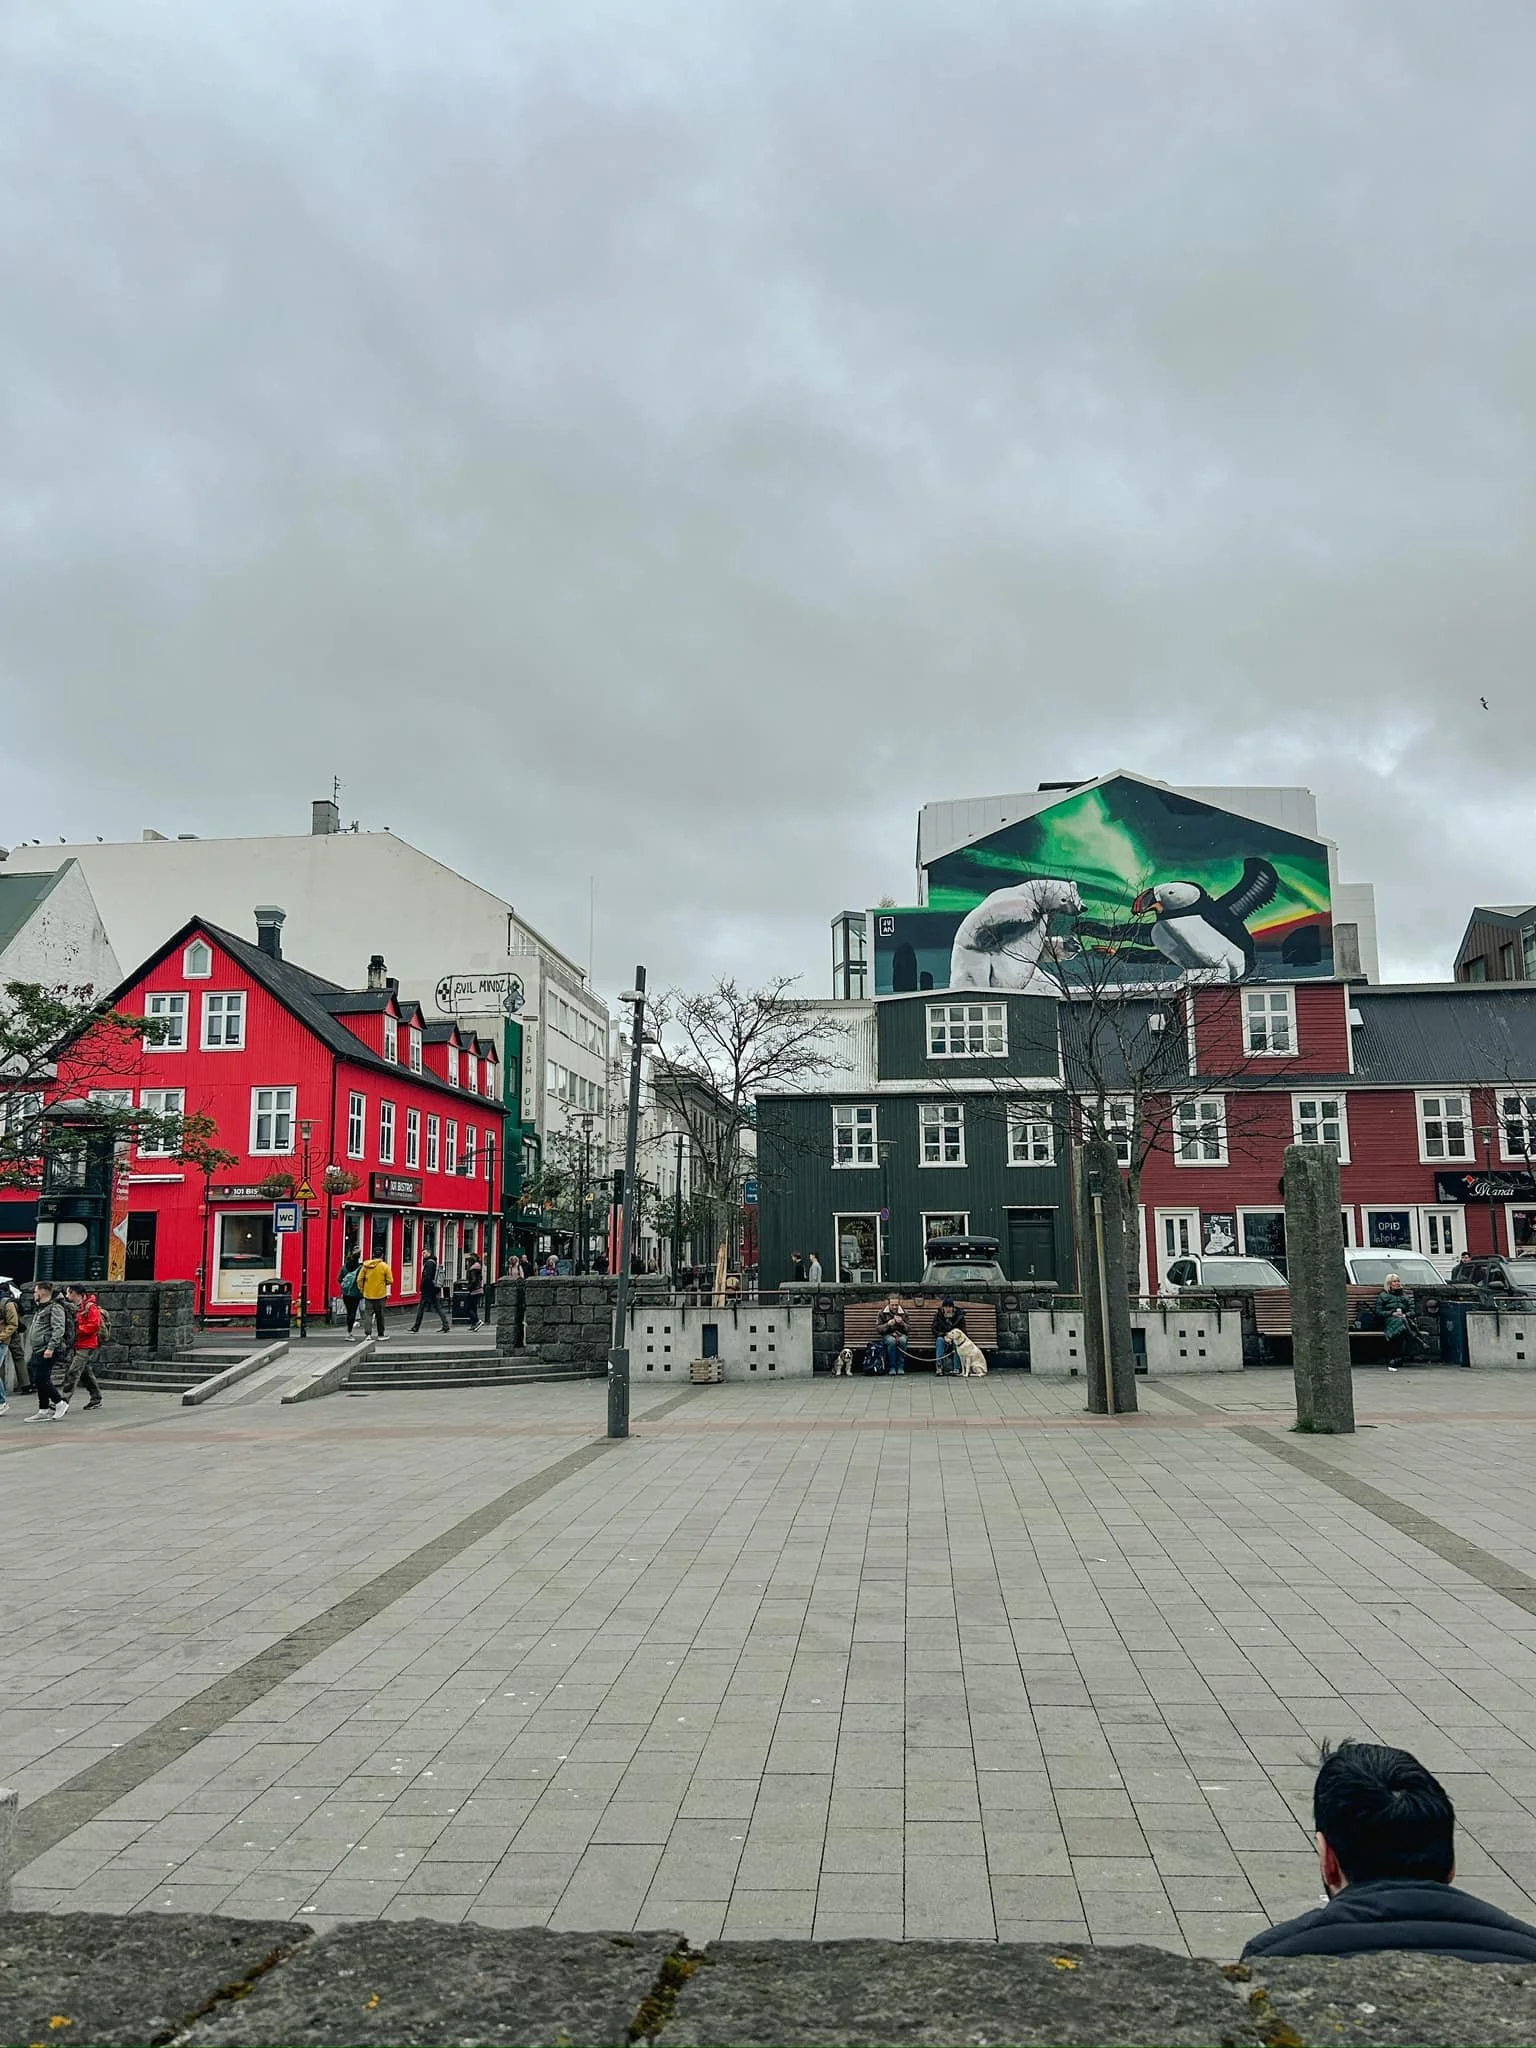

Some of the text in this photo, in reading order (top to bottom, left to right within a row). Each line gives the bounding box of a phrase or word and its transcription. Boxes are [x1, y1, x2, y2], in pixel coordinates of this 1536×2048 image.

[455, 982, 477, 994] EVIL
[525, 1024, 533, 1074] IRISH
[279, 1214, 294, 1222] WC
